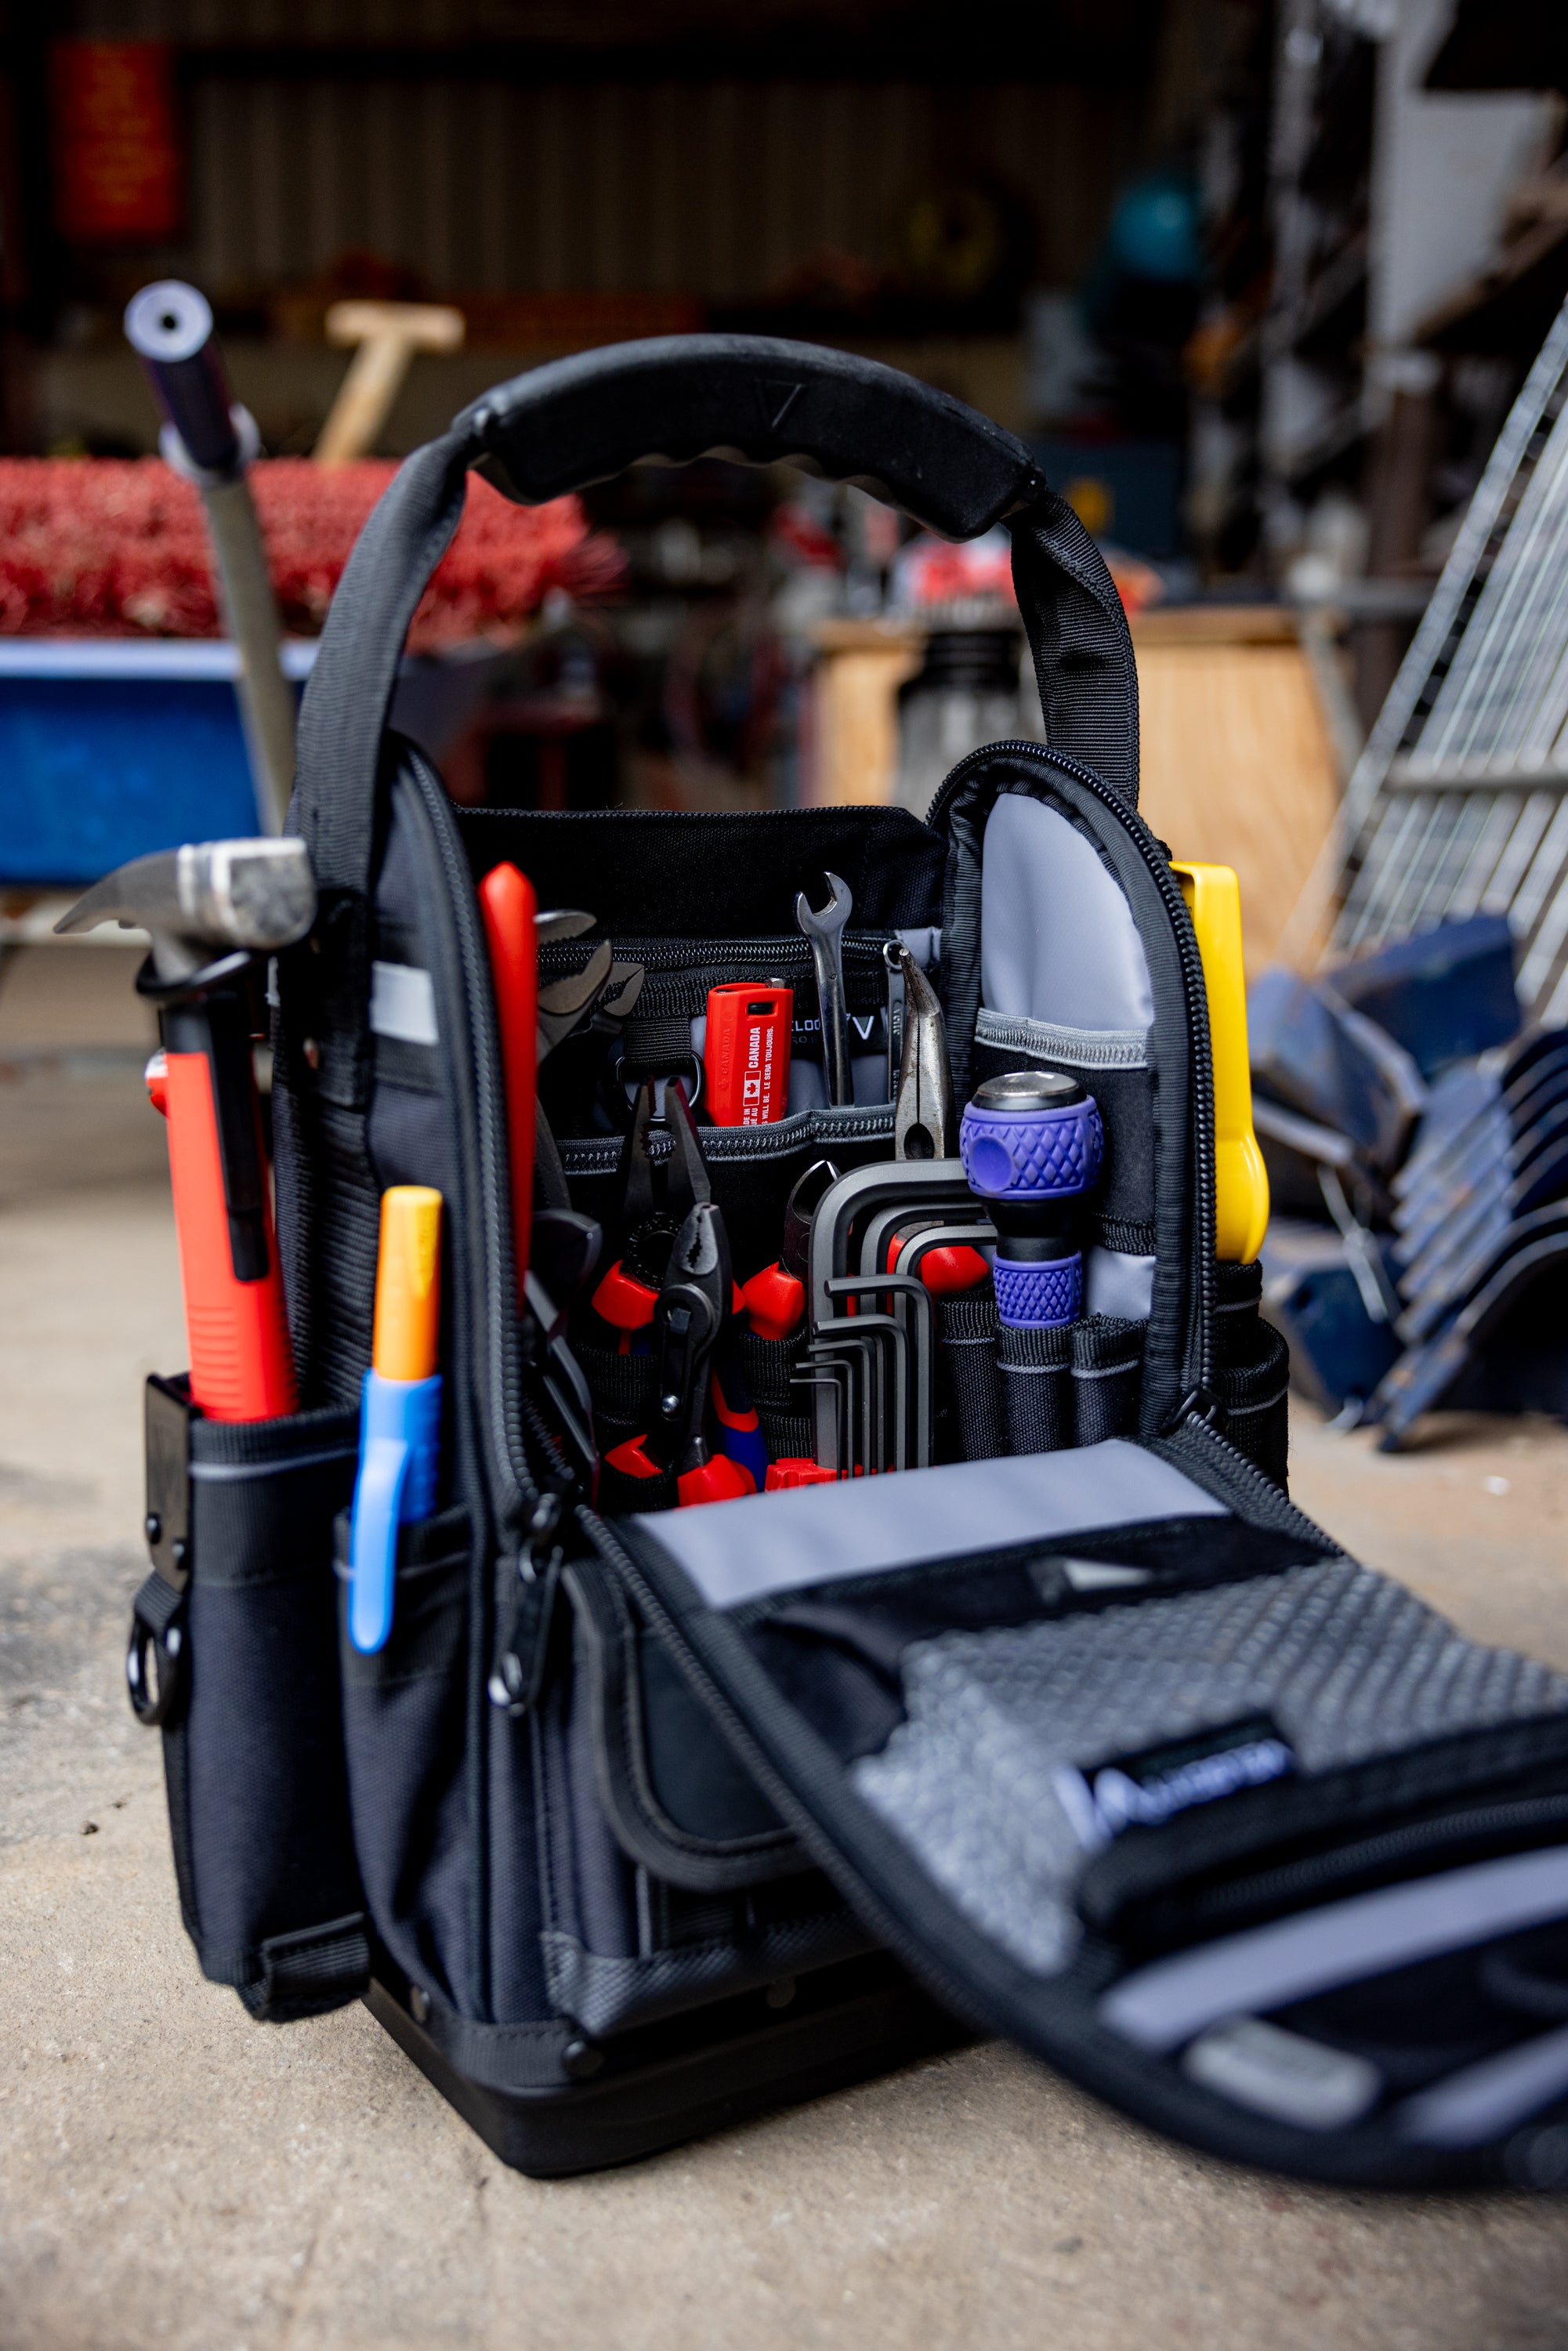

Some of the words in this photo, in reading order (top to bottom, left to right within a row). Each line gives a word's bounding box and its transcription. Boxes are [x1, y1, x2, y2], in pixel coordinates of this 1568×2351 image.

[748, 1027, 761, 1069] CANADA
[765, 1026, 774, 1063] TOUJOURS.
[763, 1081, 771, 1090] LE
[751, 1107, 759, 1117] AU
